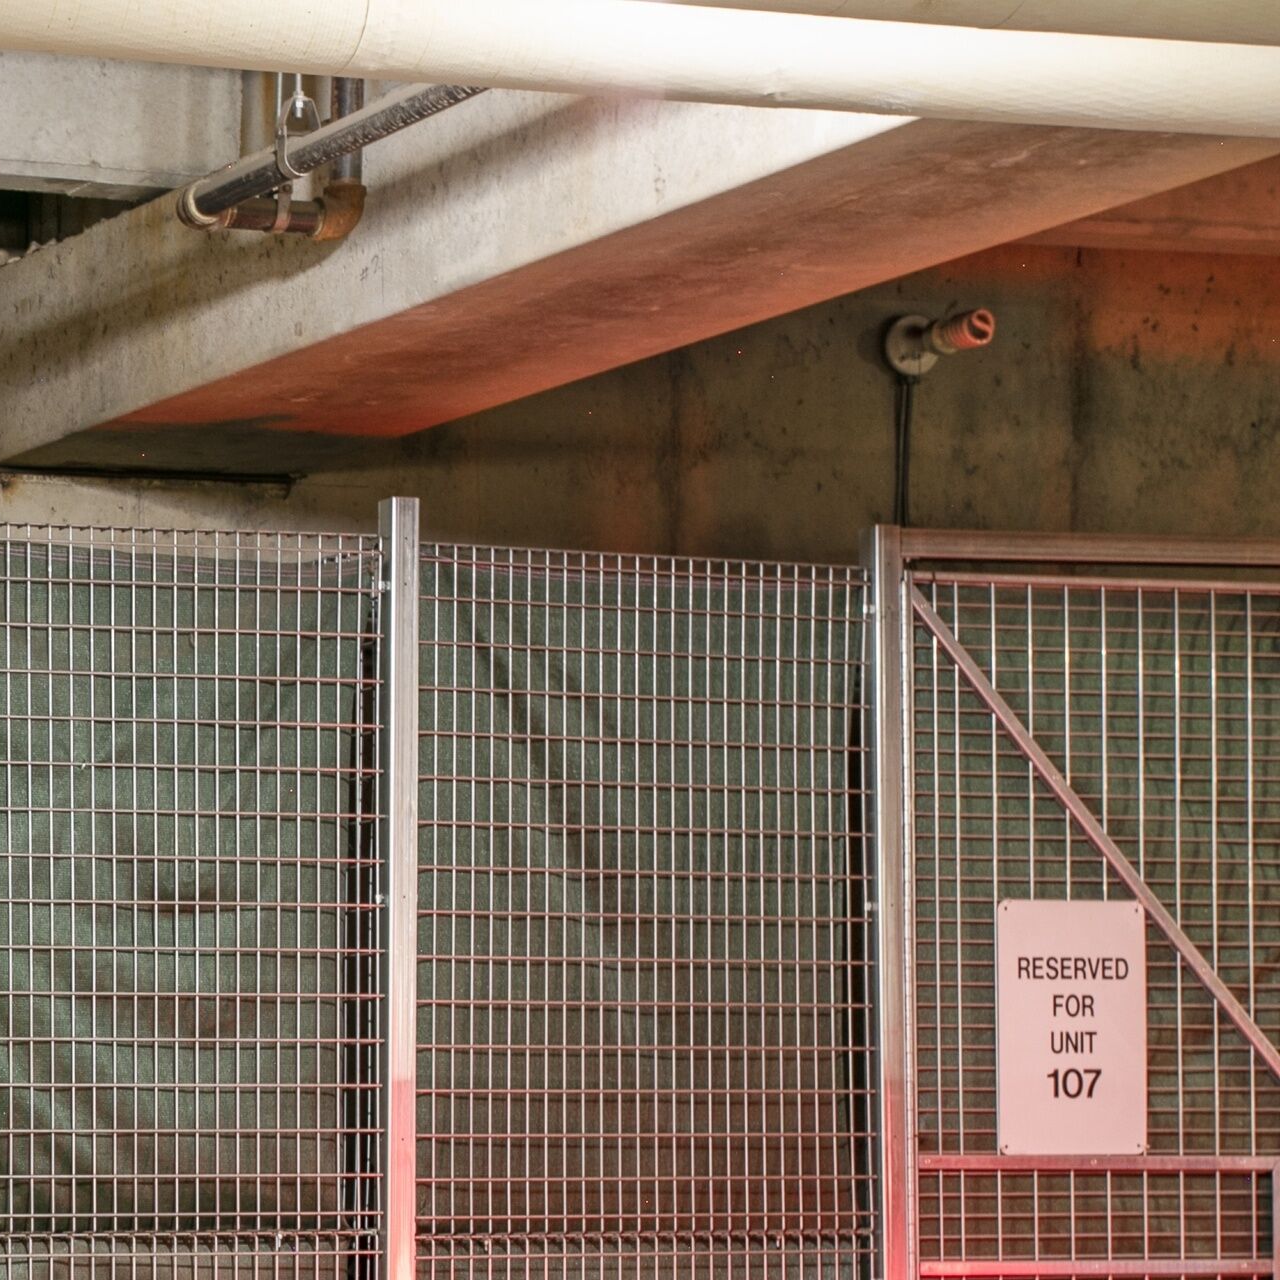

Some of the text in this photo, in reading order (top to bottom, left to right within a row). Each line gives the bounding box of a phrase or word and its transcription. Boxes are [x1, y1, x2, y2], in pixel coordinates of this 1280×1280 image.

[1017, 956, 1129, 981] RESERVED
[1052, 994, 1095, 1018] FOR
[1050, 1031, 1098, 1055] UNIT
[1046, 1068, 1102, 1099] 107
